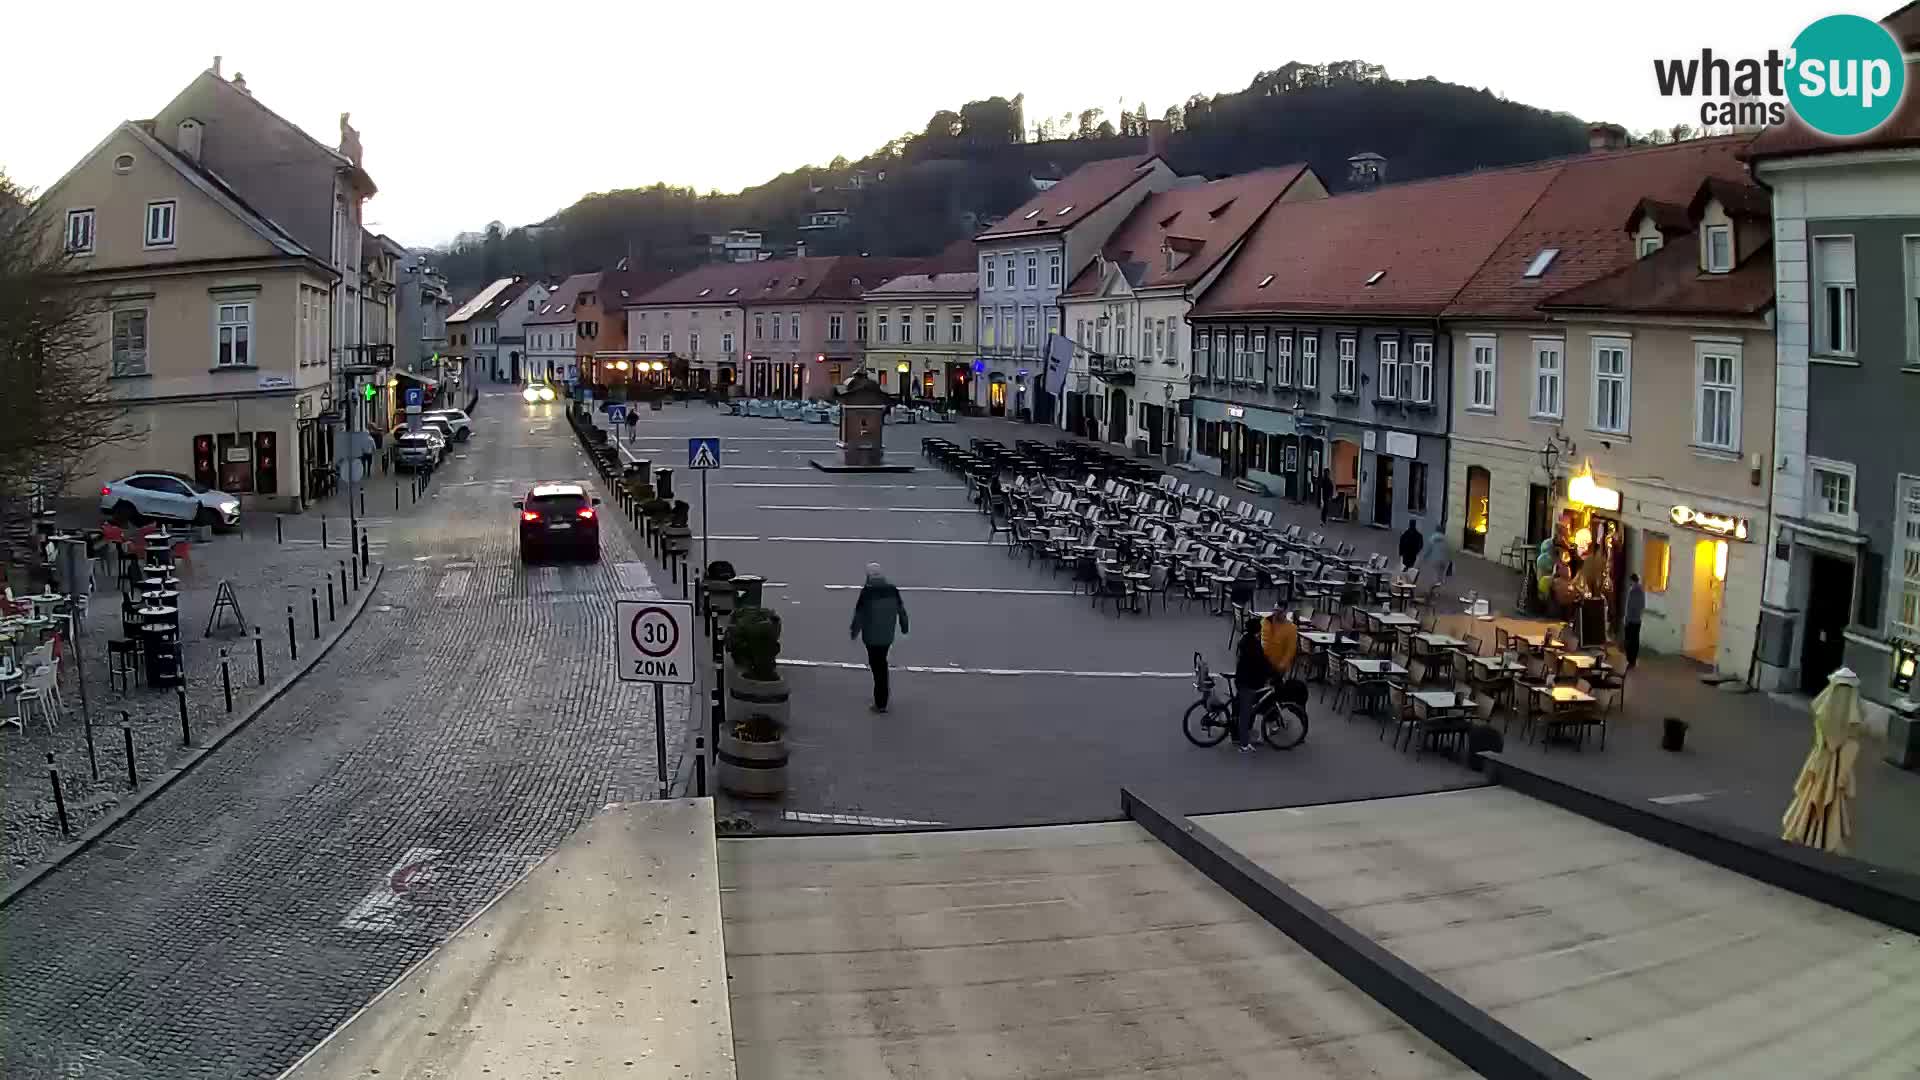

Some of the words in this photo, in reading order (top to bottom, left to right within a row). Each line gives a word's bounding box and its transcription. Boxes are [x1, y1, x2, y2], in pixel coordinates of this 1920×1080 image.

[410, 391, 418, 401] P
[643, 622, 668, 644] 30
[634, 660, 679, 677] ZONA
